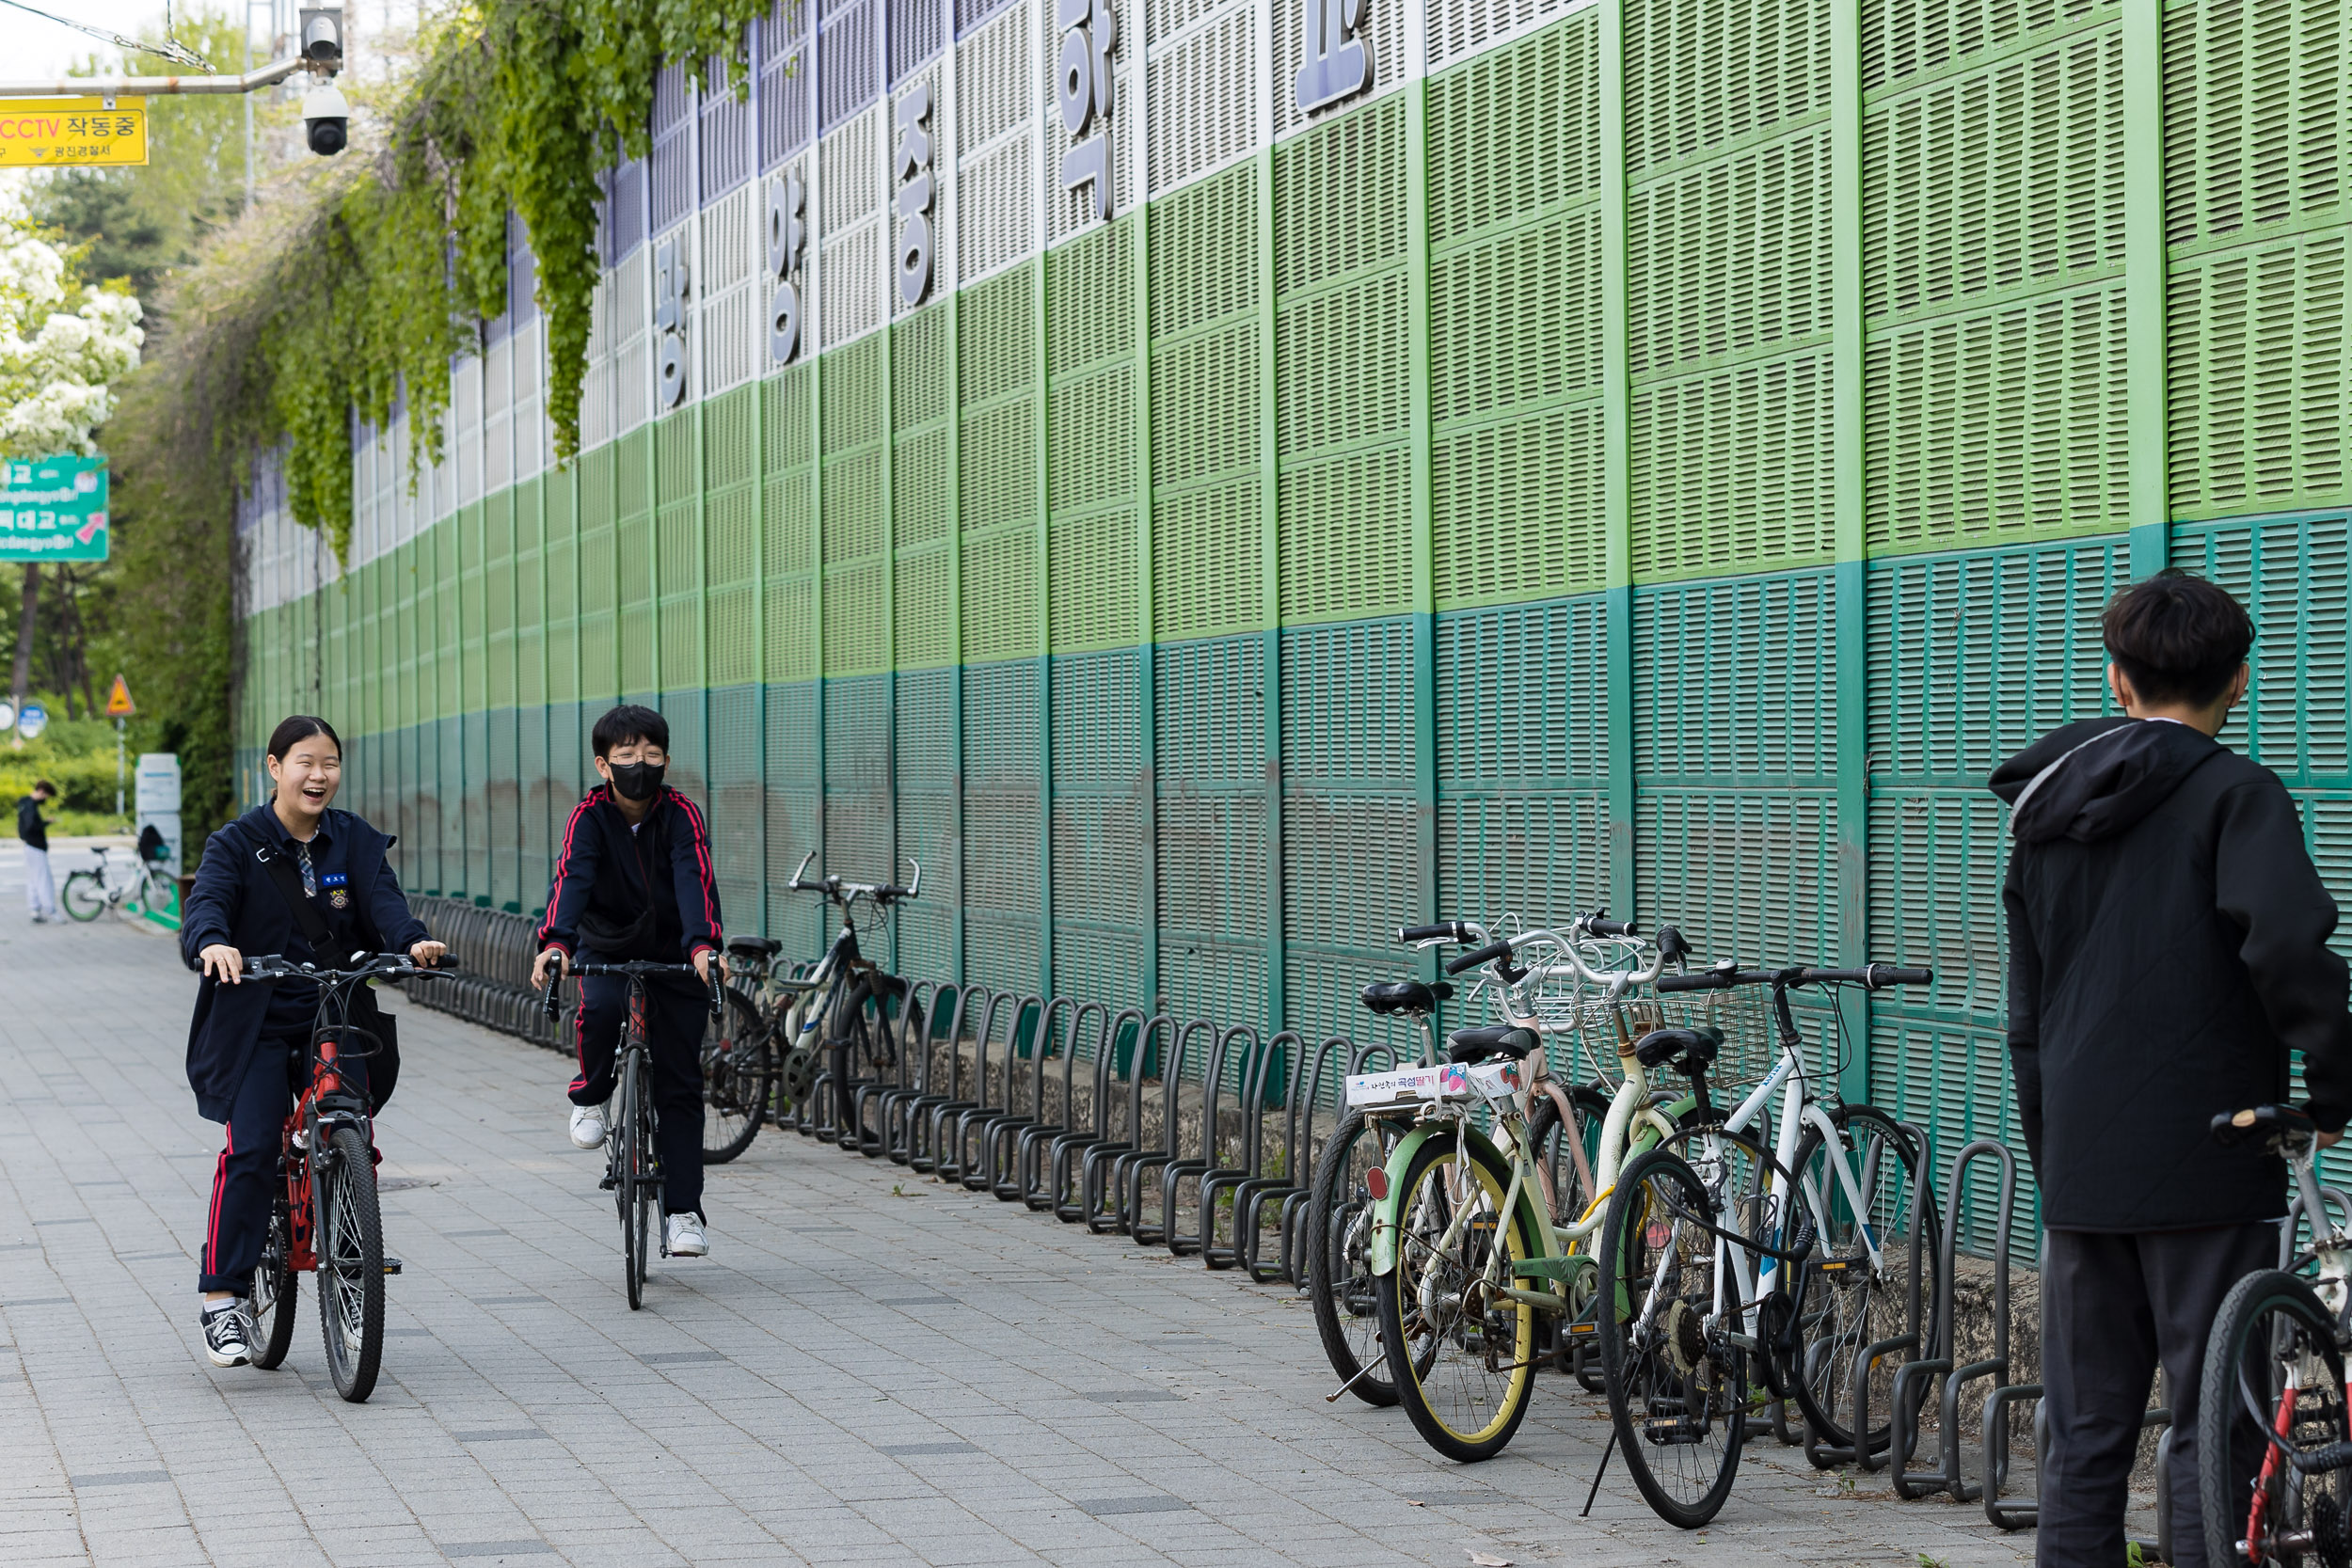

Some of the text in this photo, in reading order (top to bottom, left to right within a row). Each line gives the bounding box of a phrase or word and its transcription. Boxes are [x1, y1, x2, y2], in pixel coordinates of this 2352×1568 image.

[0, 117, 135, 139] CCTV 작동중
[55, 145, 111, 157] 광진경찰서
[1397, 1075, 1435, 1087] 곡성딸기
